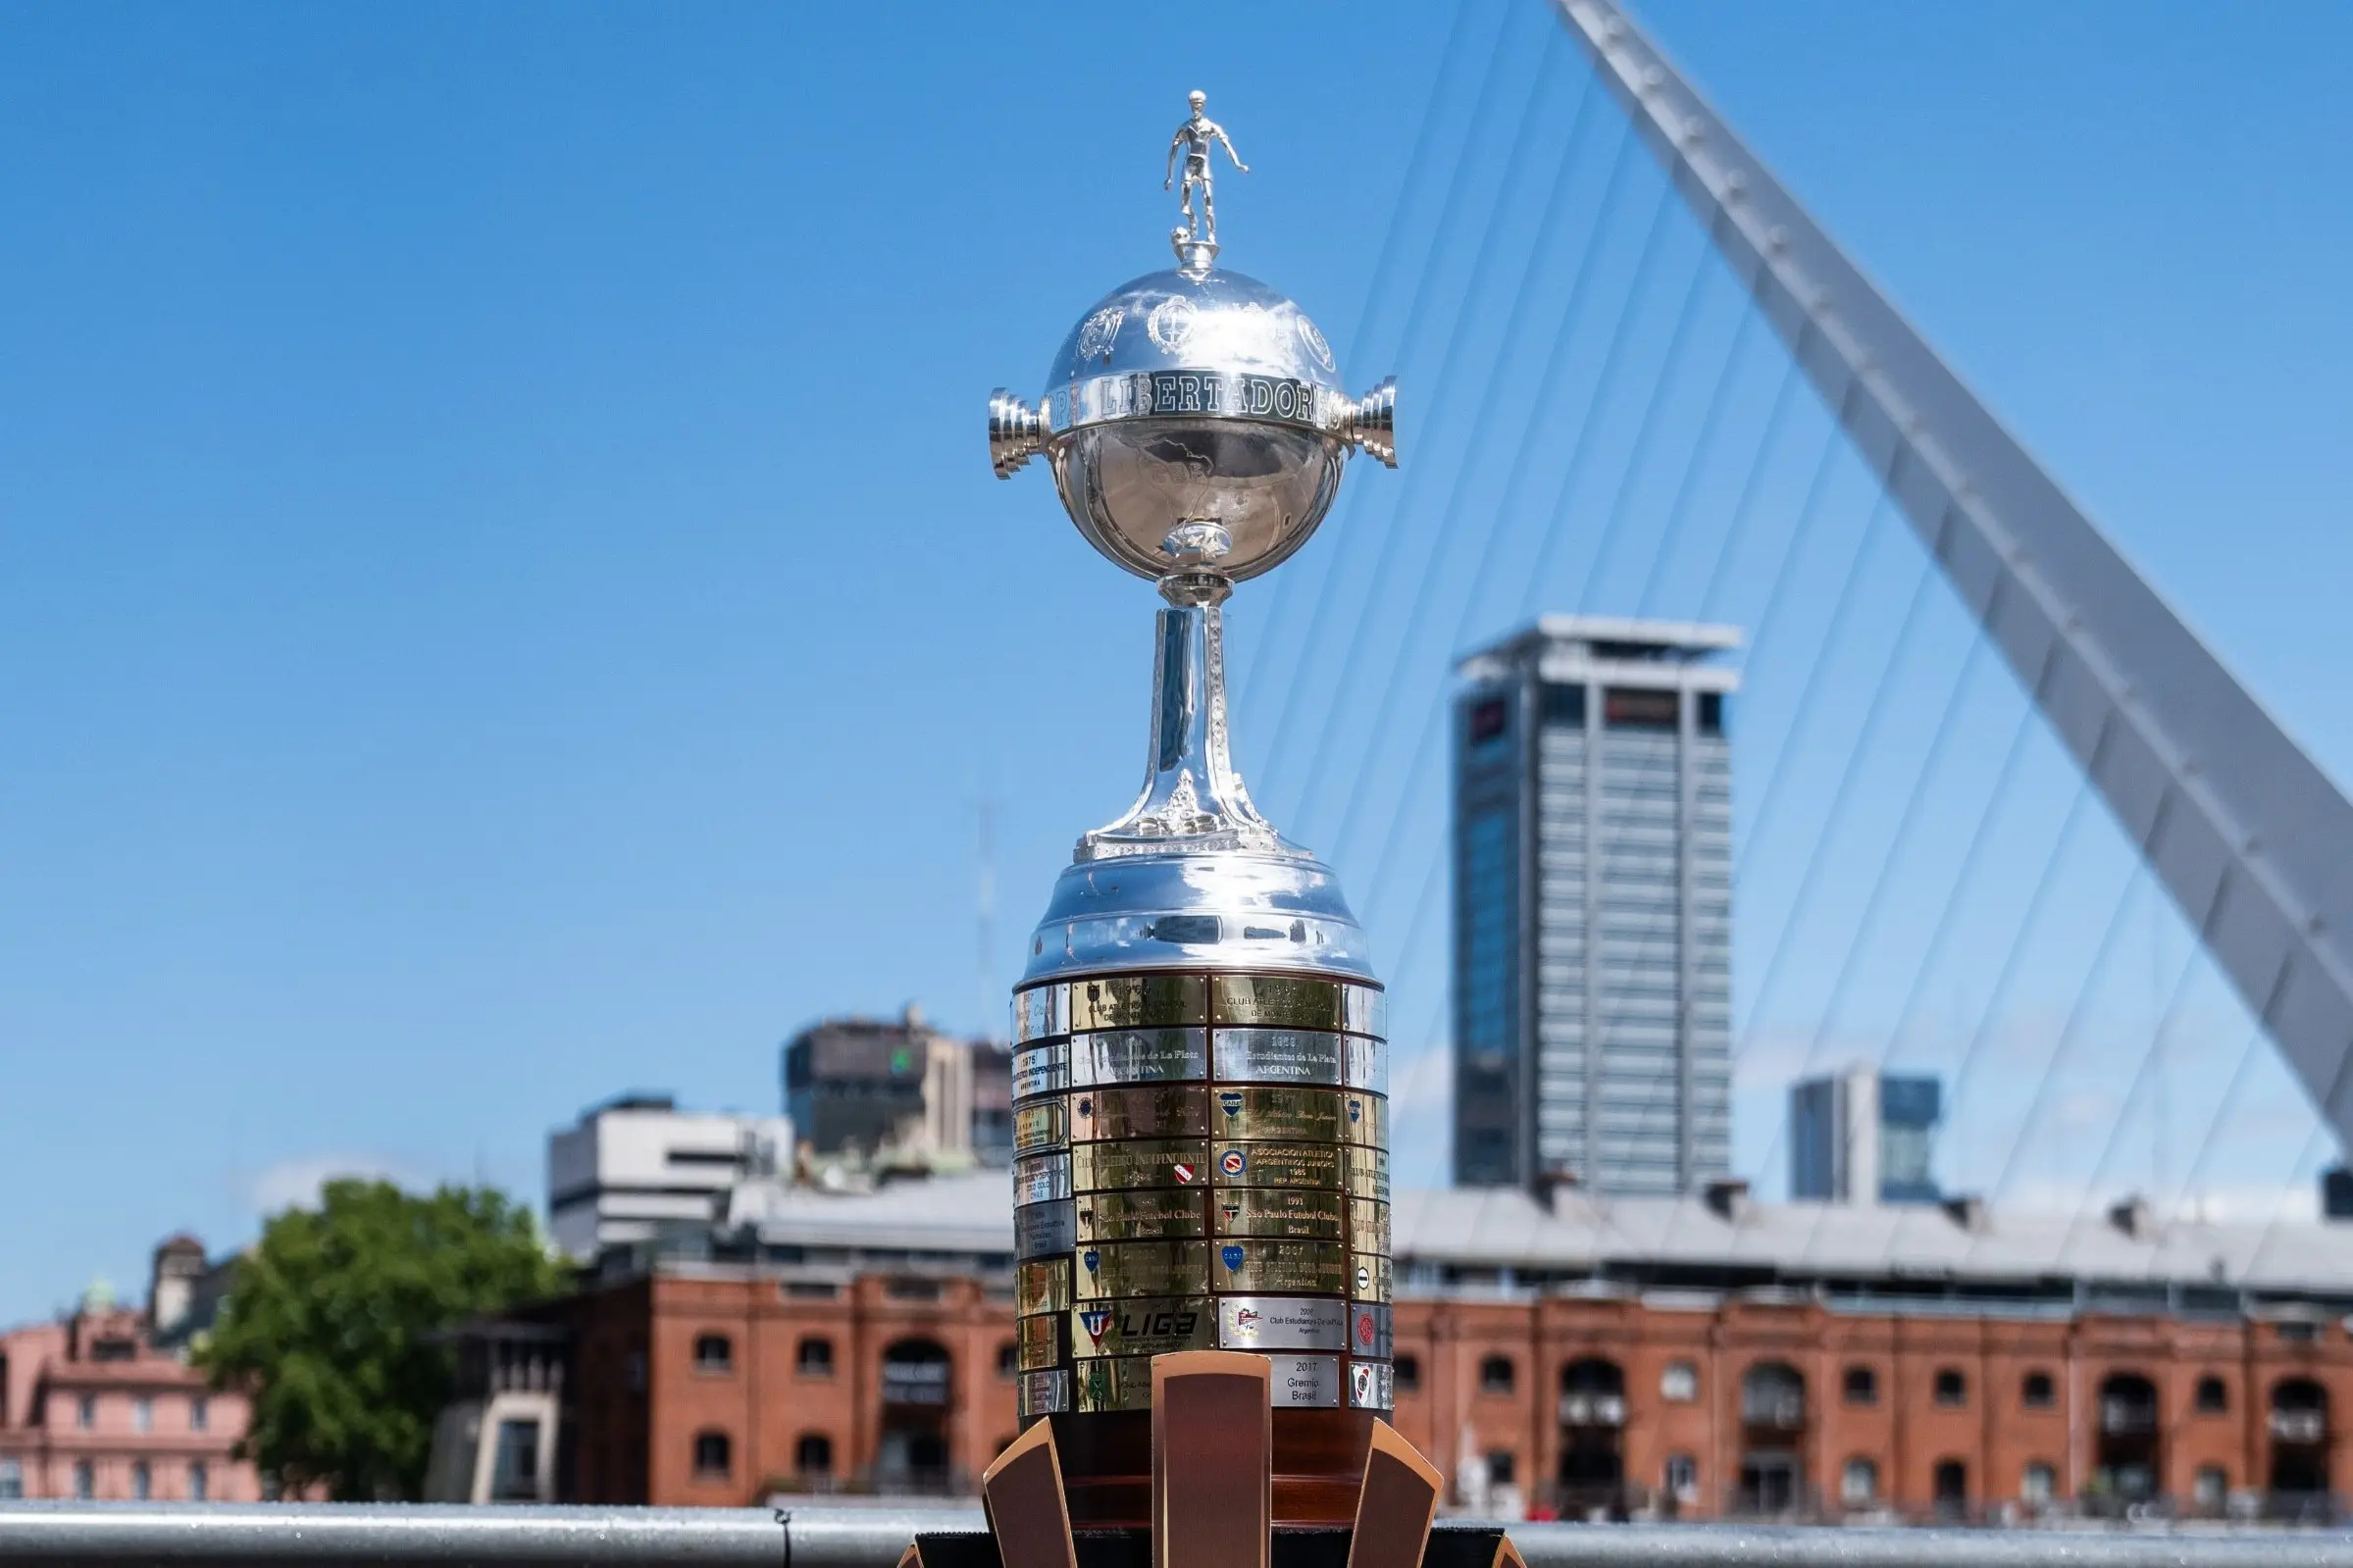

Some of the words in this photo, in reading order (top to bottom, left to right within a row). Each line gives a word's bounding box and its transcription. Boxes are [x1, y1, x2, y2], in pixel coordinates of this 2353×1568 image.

[1100, 375, 1340, 430] LIBERTADORES
[1227, 997, 1252, 1006] CLUB
[1088, 1003, 1107, 1013] CLUB
[1022, 1055, 1036, 1067] 1975
[1256, 1065, 1311, 1076] ARGENTINA
[1135, 1149, 1205, 1165] INDEPENDIENTE
[1287, 1196, 1304, 1205] 1993
[1174, 1208, 1202, 1219] Clube
[1264, 1209, 1287, 1219] Paulo
[1289, 1210, 1316, 1220] Futebol
[1288, 1225, 1309, 1234] Brasil
[1090, 1315, 1104, 1336] U
[1285, 1317, 1316, 1326] Estudiantes
[1296, 1361, 1318, 1372] 2017
[1292, 1390, 1317, 1401] Brasil
